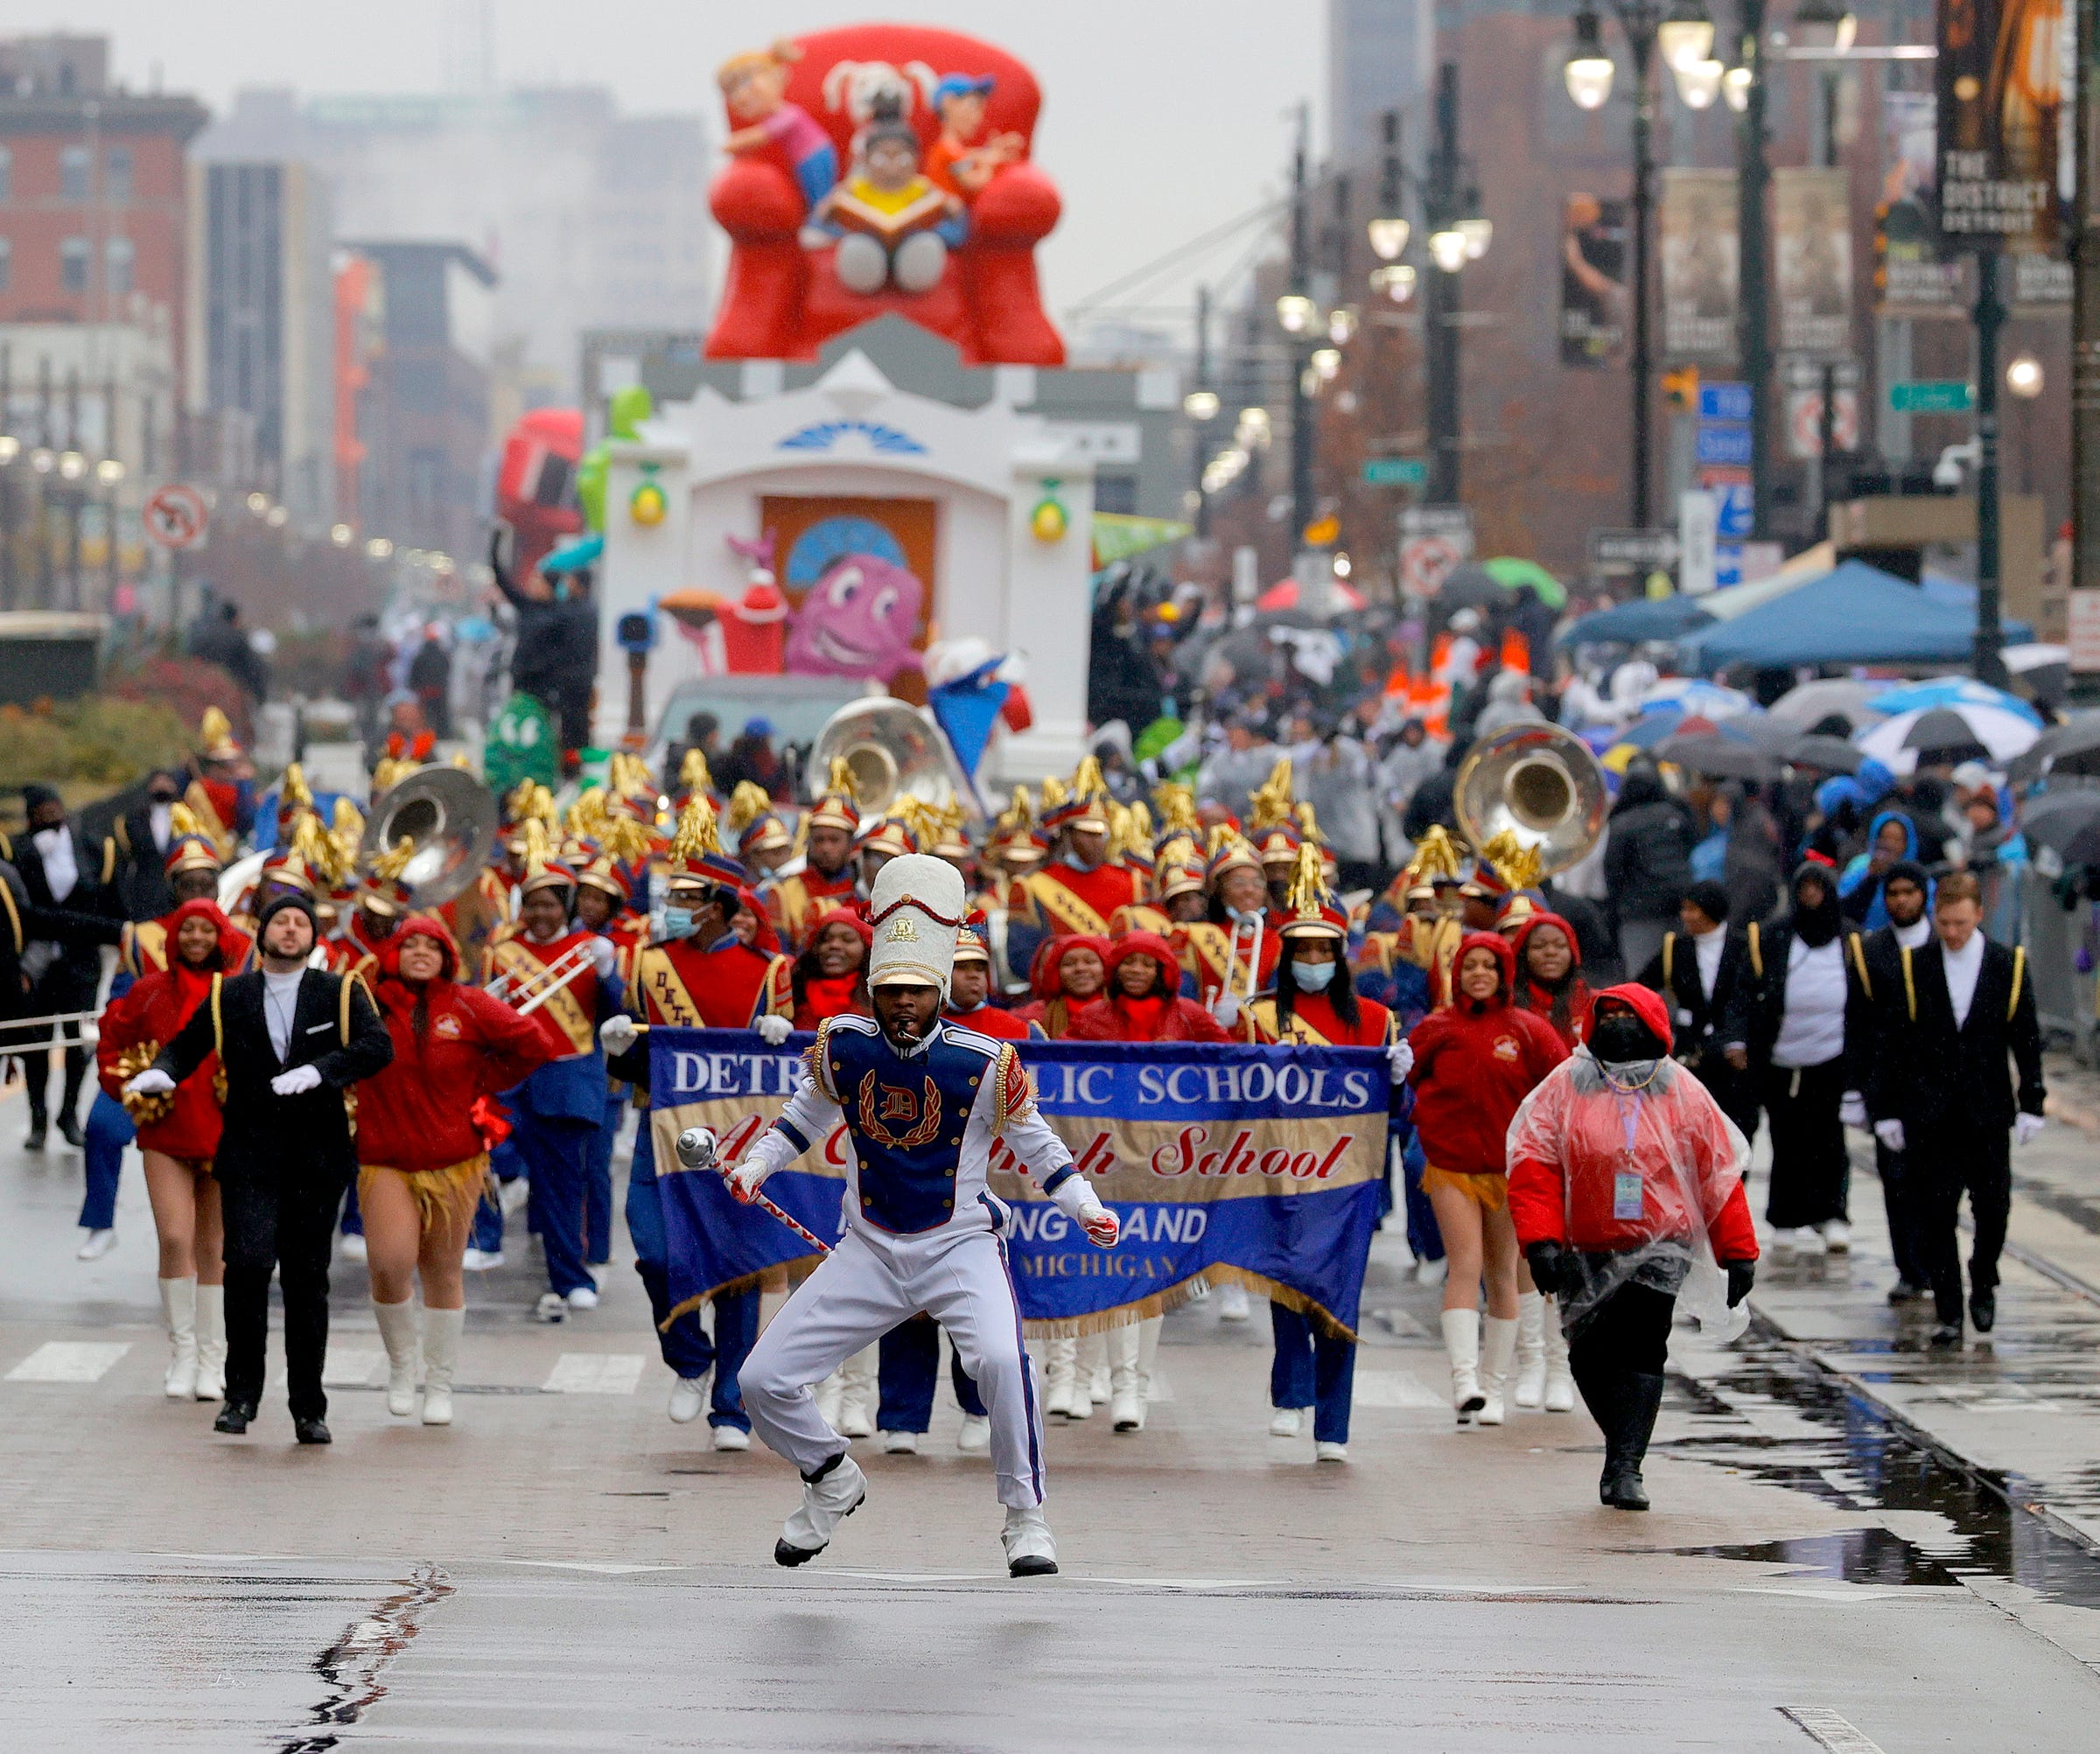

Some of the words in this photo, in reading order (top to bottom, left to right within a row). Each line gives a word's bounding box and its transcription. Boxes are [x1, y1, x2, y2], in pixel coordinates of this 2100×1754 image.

[657, 971, 692, 1026] DETR
[672, 1052, 804, 1094] DETR
[1025, 1064, 1114, 1104] LIC
[1138, 1062, 1369, 1108] SCHOOLS
[880, 1082, 918, 1121] D
[1151, 1125, 1354, 1178] School
[1119, 1206, 1208, 1243] AND
[1021, 1253, 1179, 1278] MICHIGAN
